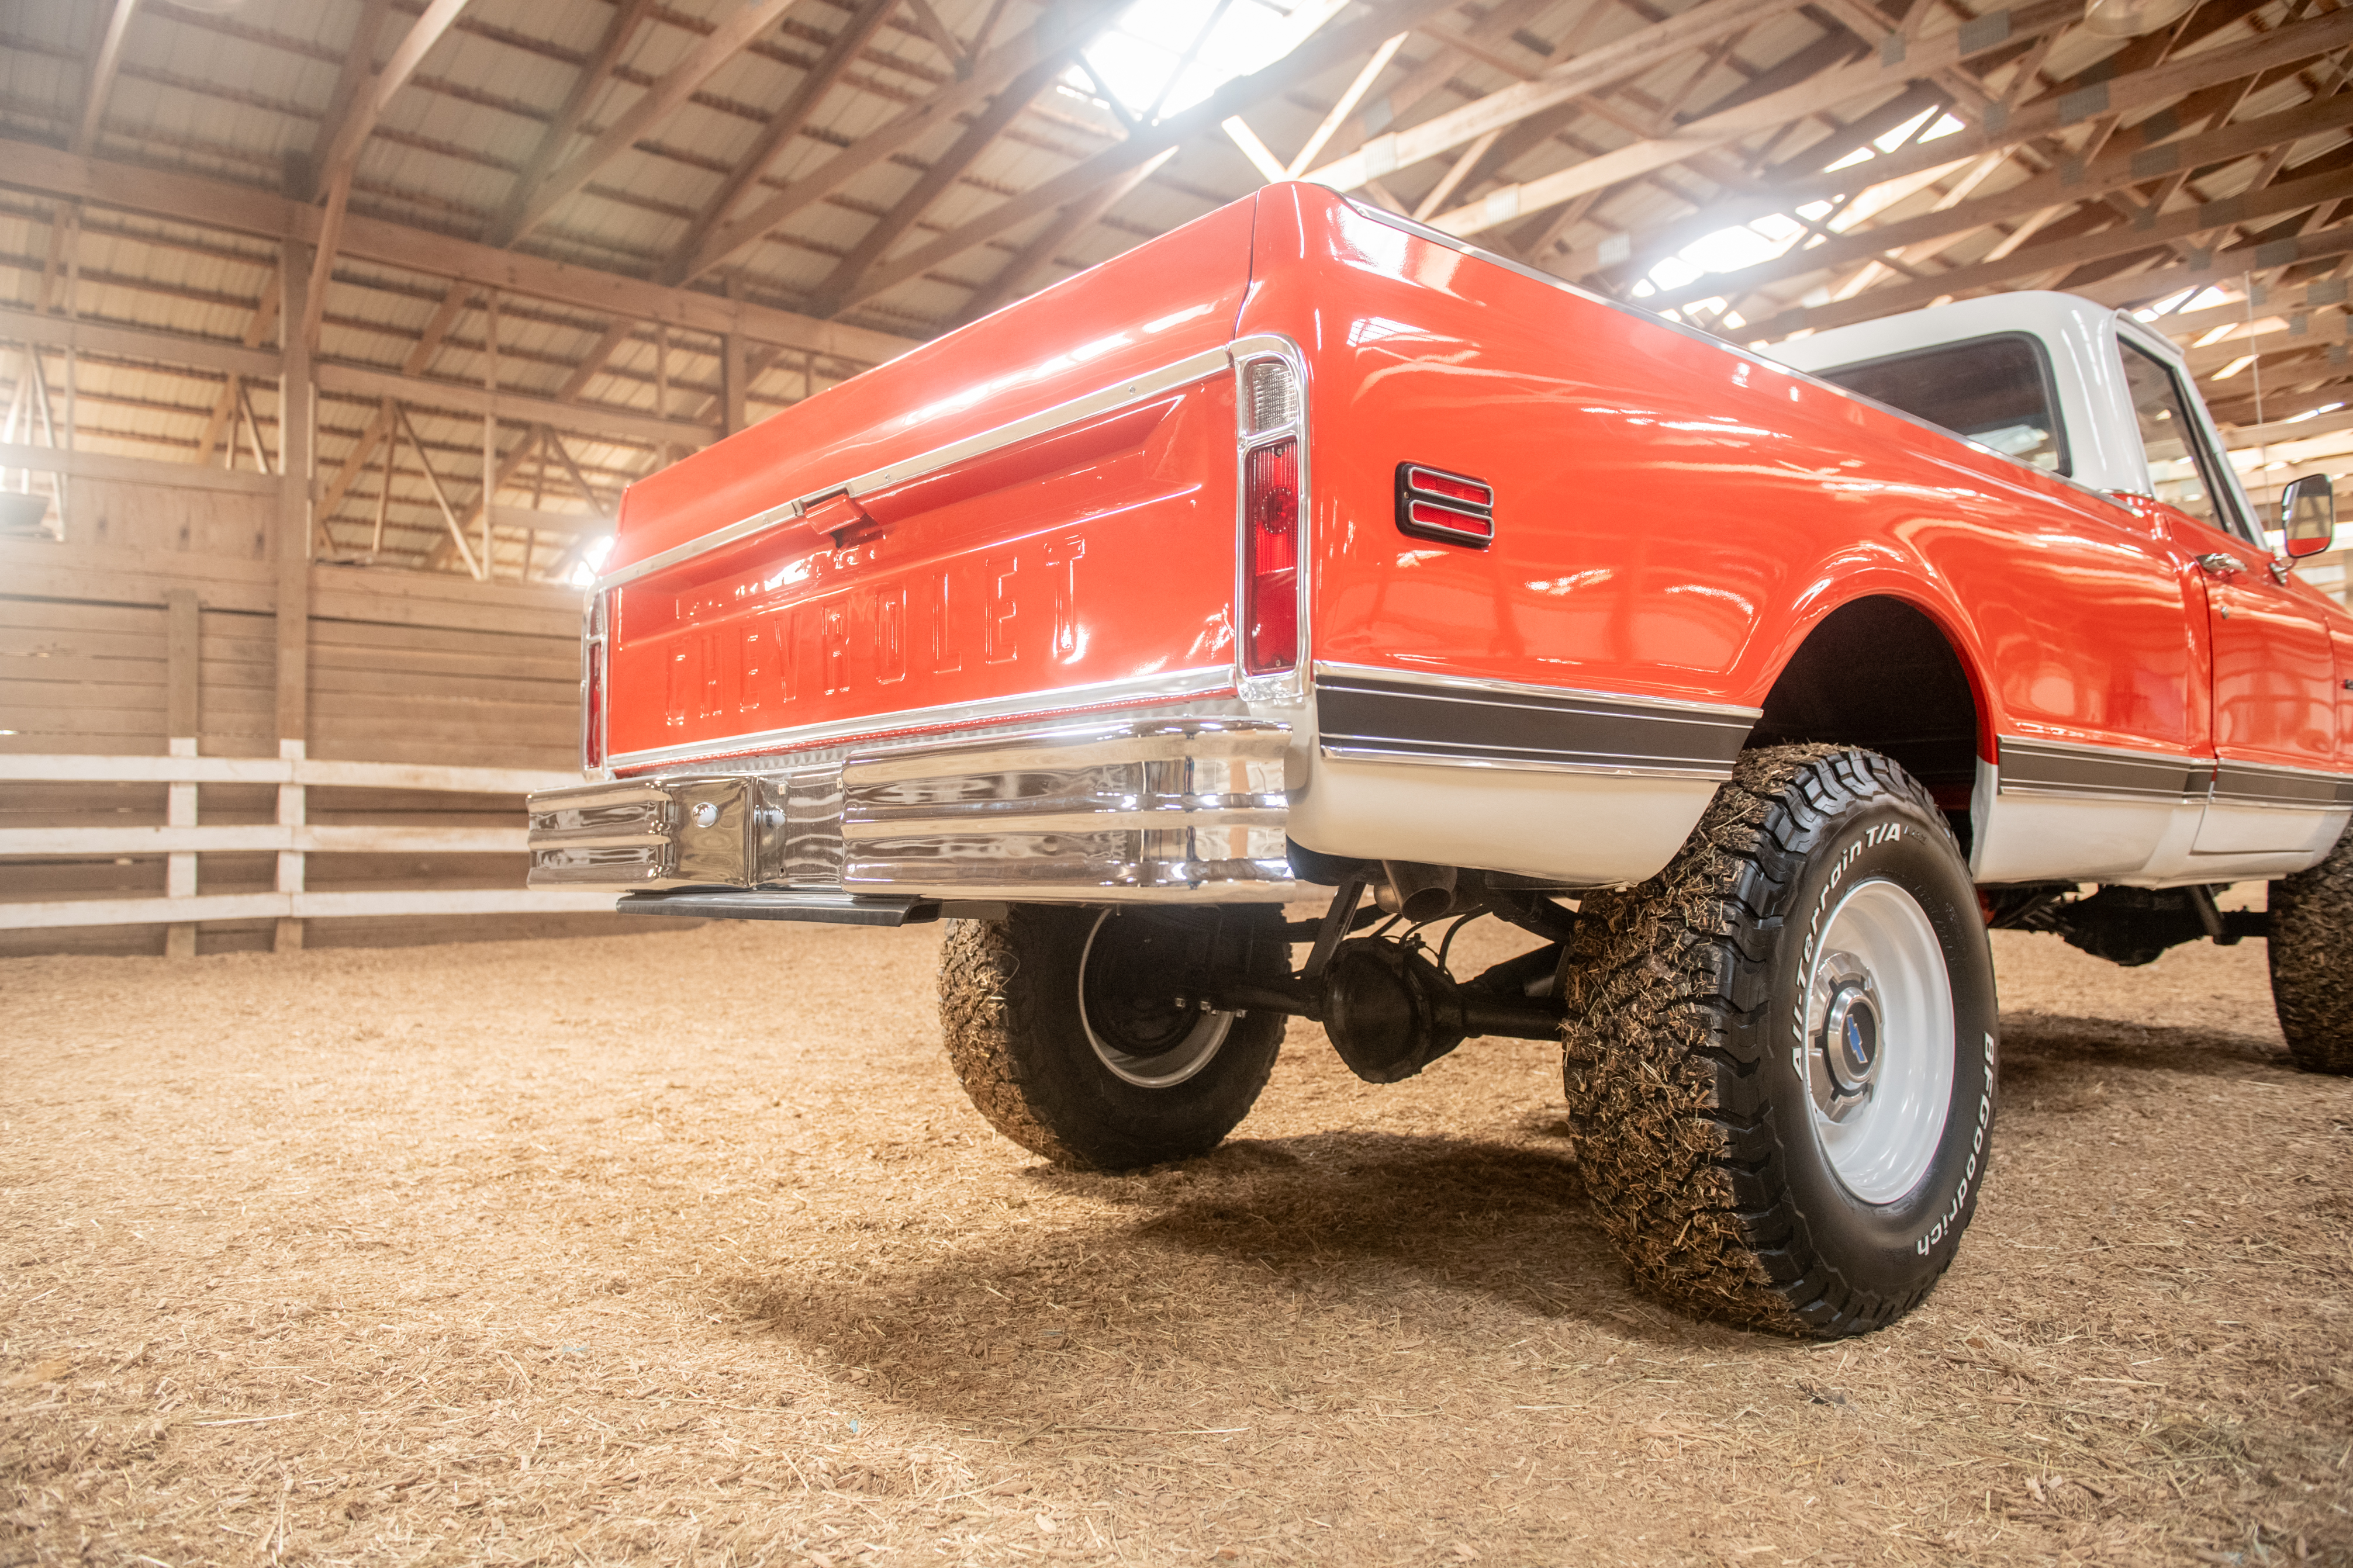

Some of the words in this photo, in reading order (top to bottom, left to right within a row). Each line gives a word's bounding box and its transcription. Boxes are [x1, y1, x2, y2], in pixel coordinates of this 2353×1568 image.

[665, 532, 1086, 726] CHEVROLET
[1792, 840, 1863, 1081] All-Terrain
[1865, 822, 1901, 848] T/A
[1916, 1032, 1994, 1256] BFGoodrich
